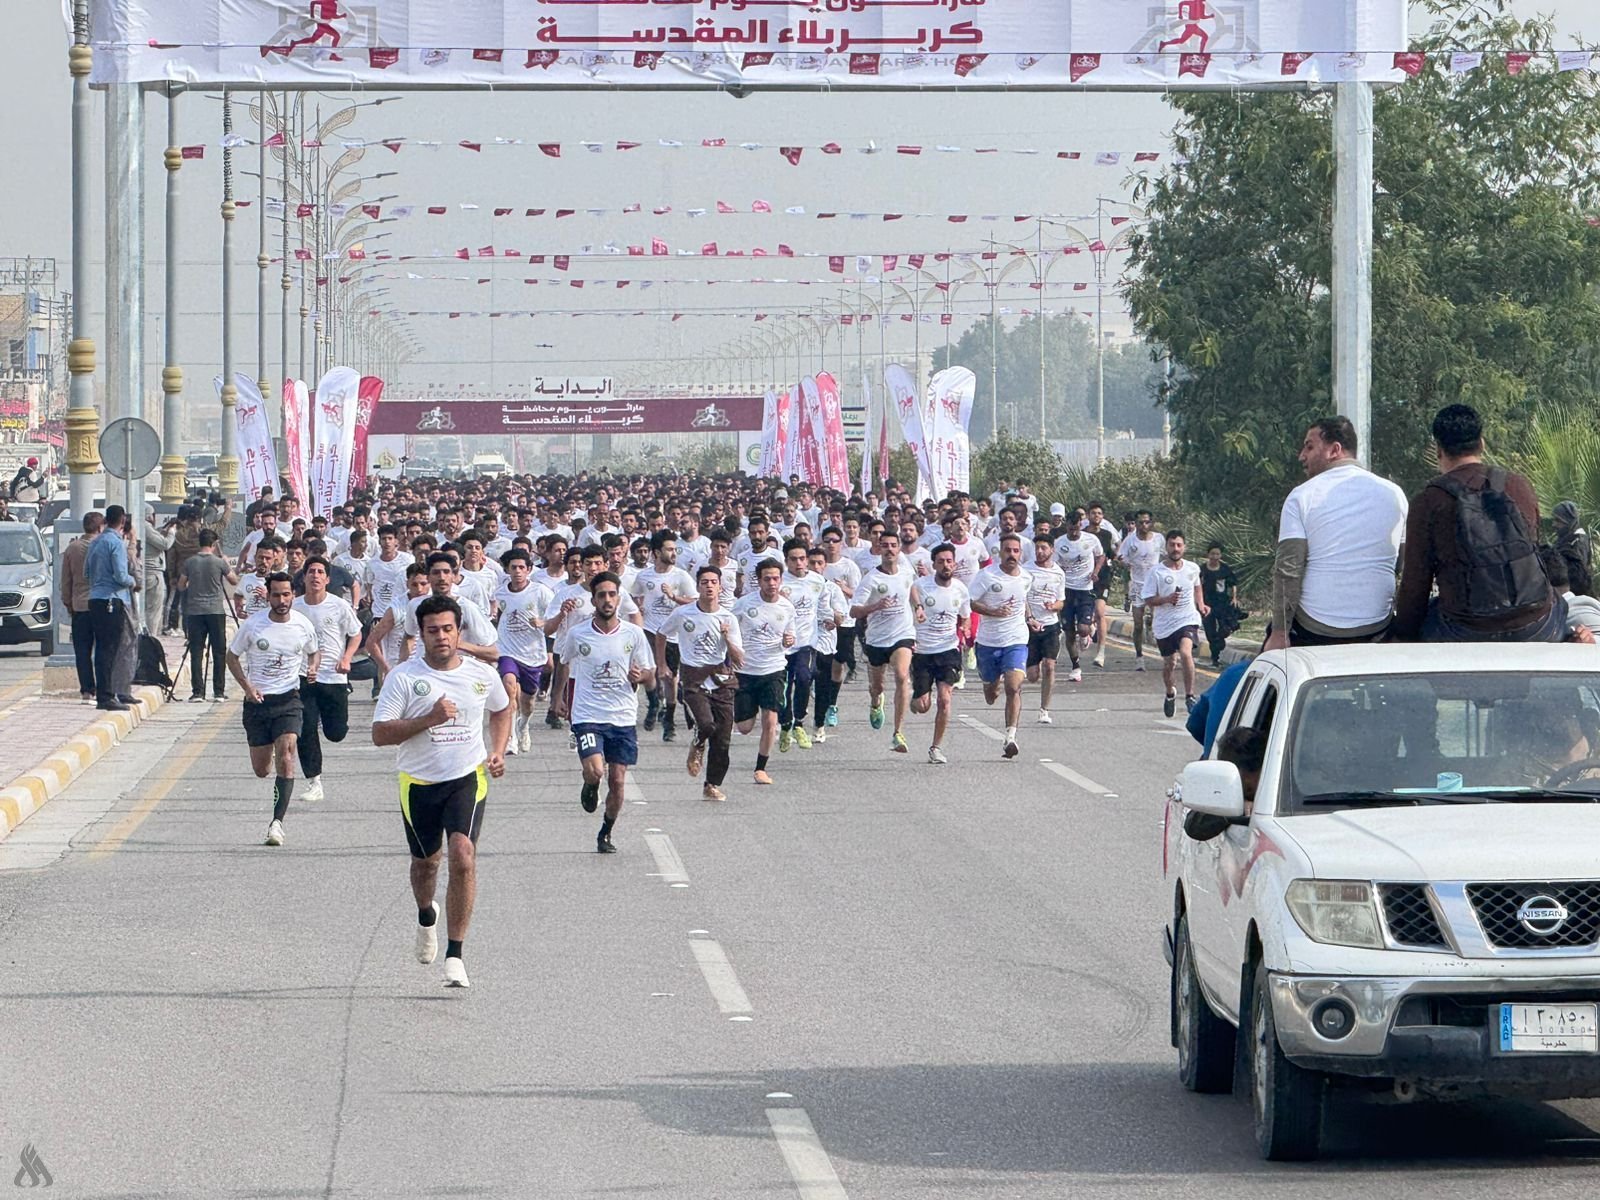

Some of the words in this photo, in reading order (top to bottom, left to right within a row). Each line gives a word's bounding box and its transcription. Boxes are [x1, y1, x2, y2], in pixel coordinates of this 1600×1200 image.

[536, 16, 768, 43] المقدسة
[534, 377, 612, 399] البداية
[501, 404, 556, 413] محافظة
[557, 405, 593, 414] يوم
[593, 402, 645, 414] ماراثون
[502, 414, 576, 425] المقدسة
[580, 733, 597, 751] 20
[1522, 910, 1563, 918] NISSAN
